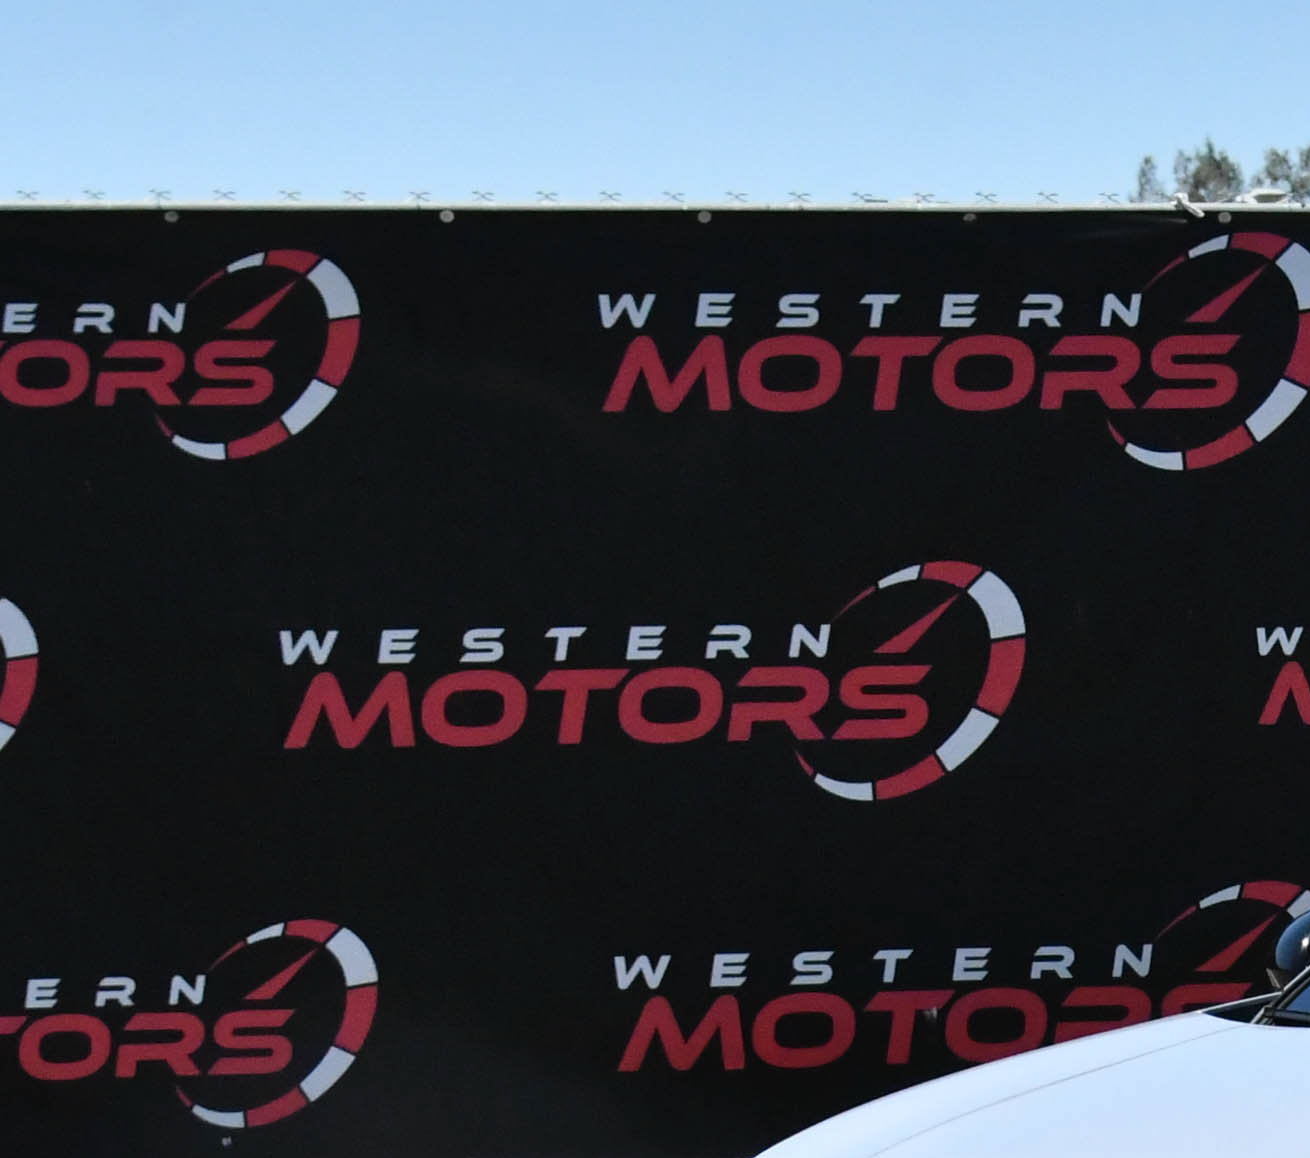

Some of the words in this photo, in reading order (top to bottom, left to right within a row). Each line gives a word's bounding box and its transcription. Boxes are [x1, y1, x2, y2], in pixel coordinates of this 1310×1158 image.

[2, 302, 186, 334] ERN
[598, 293, 1142, 329] WESTERN
[604, 334, 1241, 412] MOTORS
[279, 624, 831, 665] WESTERN
[284, 664, 932, 749] MOTORS
[614, 943, 1153, 990] WESTERN
[24, 974, 206, 1009] ERN
